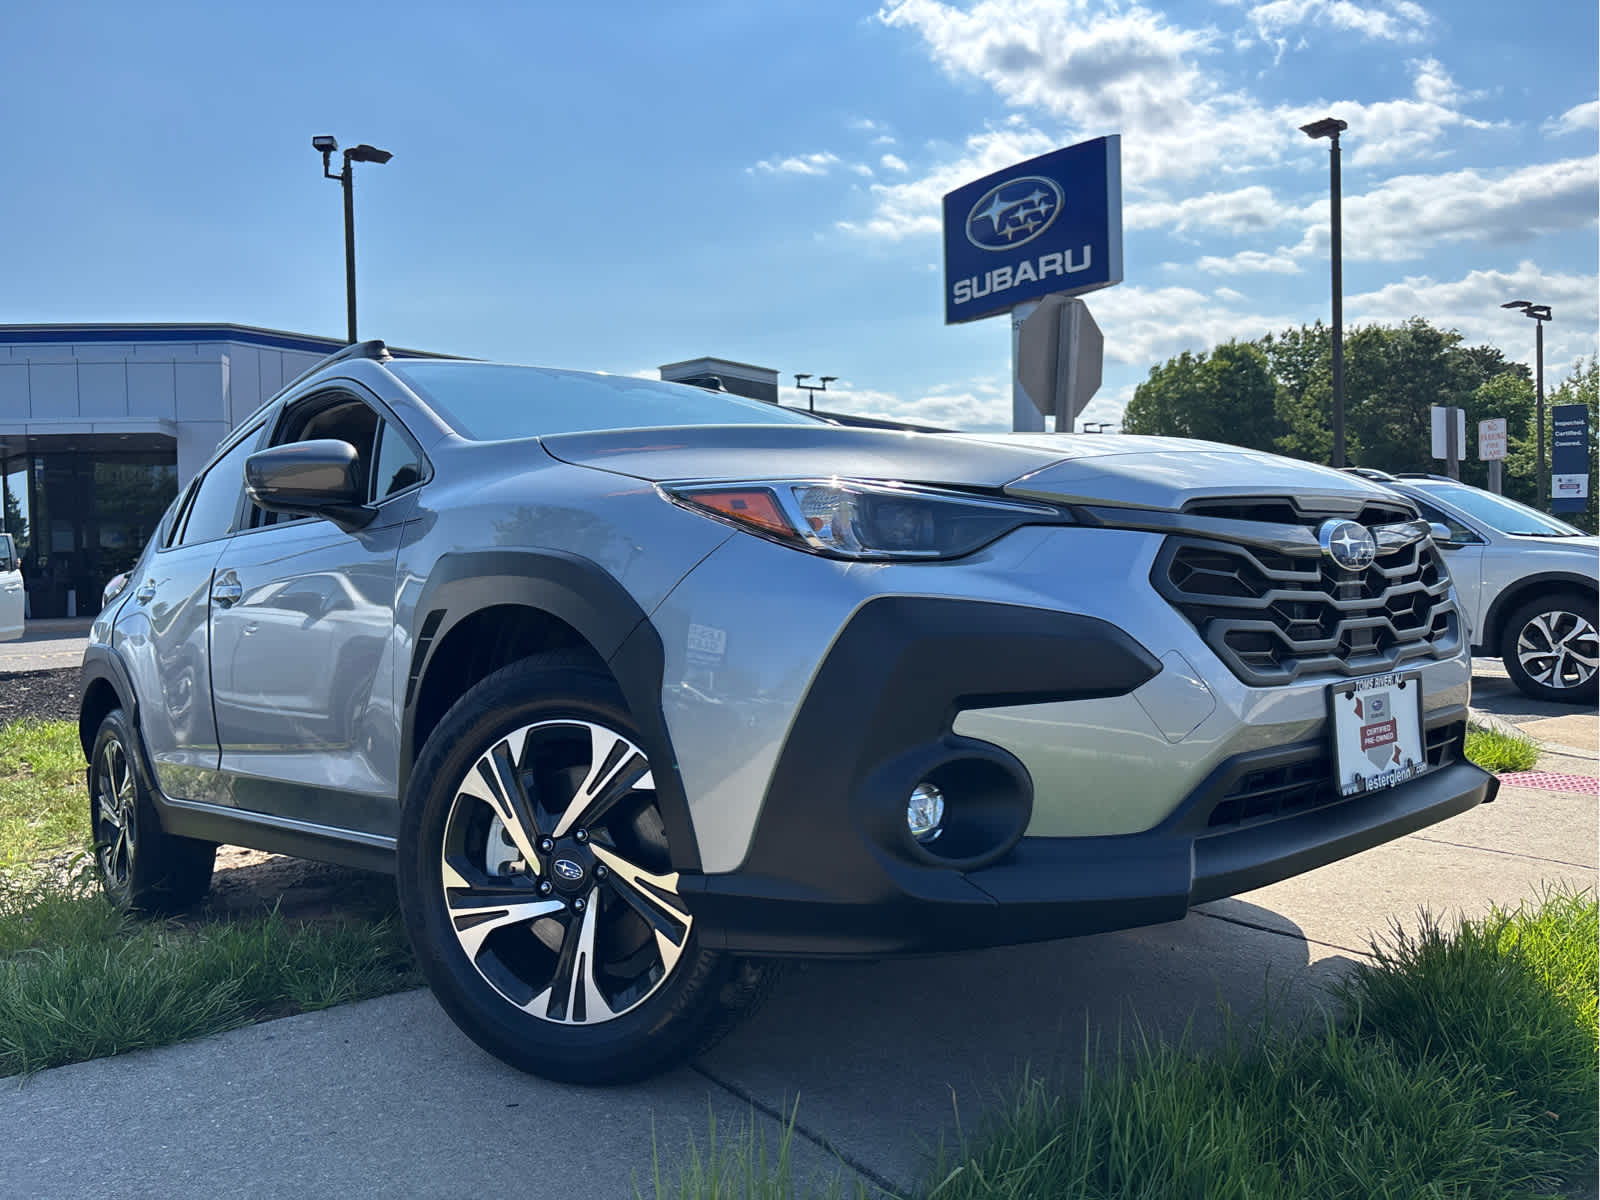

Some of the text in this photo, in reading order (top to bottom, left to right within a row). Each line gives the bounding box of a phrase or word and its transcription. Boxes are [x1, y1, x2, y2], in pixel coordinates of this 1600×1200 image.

[953, 245, 1092, 304] SUBARU
[1354, 678, 1374, 692] TOMS
[1366, 724, 1391, 736] CERTIFIED
[1364, 732, 1394, 744] PRE-OWNED
